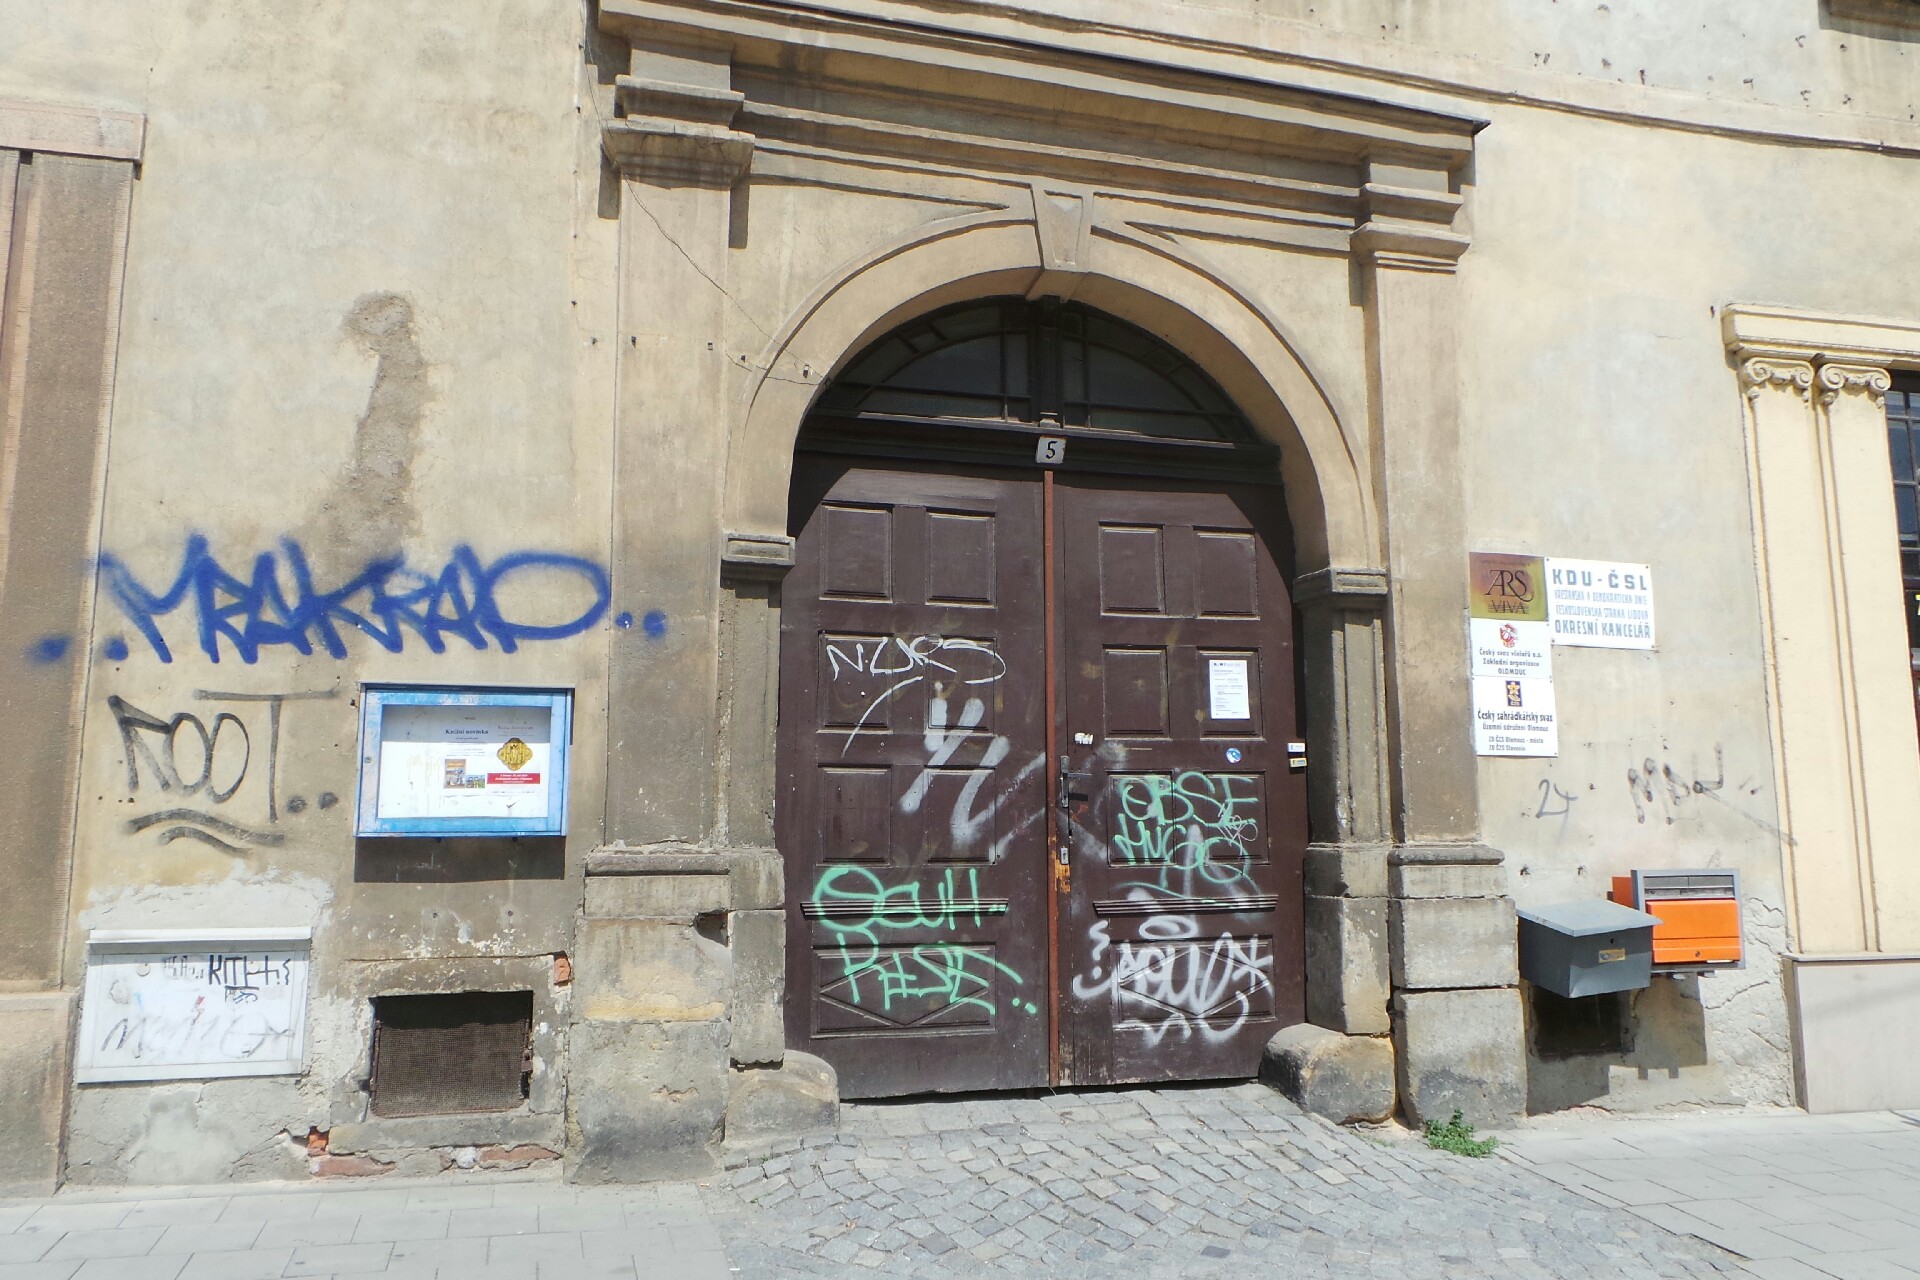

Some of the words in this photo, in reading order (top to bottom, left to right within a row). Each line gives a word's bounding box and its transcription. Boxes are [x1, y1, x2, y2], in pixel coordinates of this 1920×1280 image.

[1046, 441, 1057, 459] 5
[1483, 569, 1535, 603] ARS
[1487, 600, 1531, 614] VIVA
[1555, 618, 1598, 636] OKRESNÍ
[1601, 621, 1651, 639] KANCELÁŘ
[1479, 647, 1495, 656] Český
[1483, 658, 1508, 666] Základní
[1509, 660, 1540, 668] organizace
[1477, 708, 1495, 722] Český
[1497, 710, 1538, 723] zahrádkářský
[1539, 714, 1553, 722] svaz
[1483, 721, 1502, 730] Územní
[1503, 723, 1526, 731] sdružení
[1527, 724, 1549, 732] Olomouc
